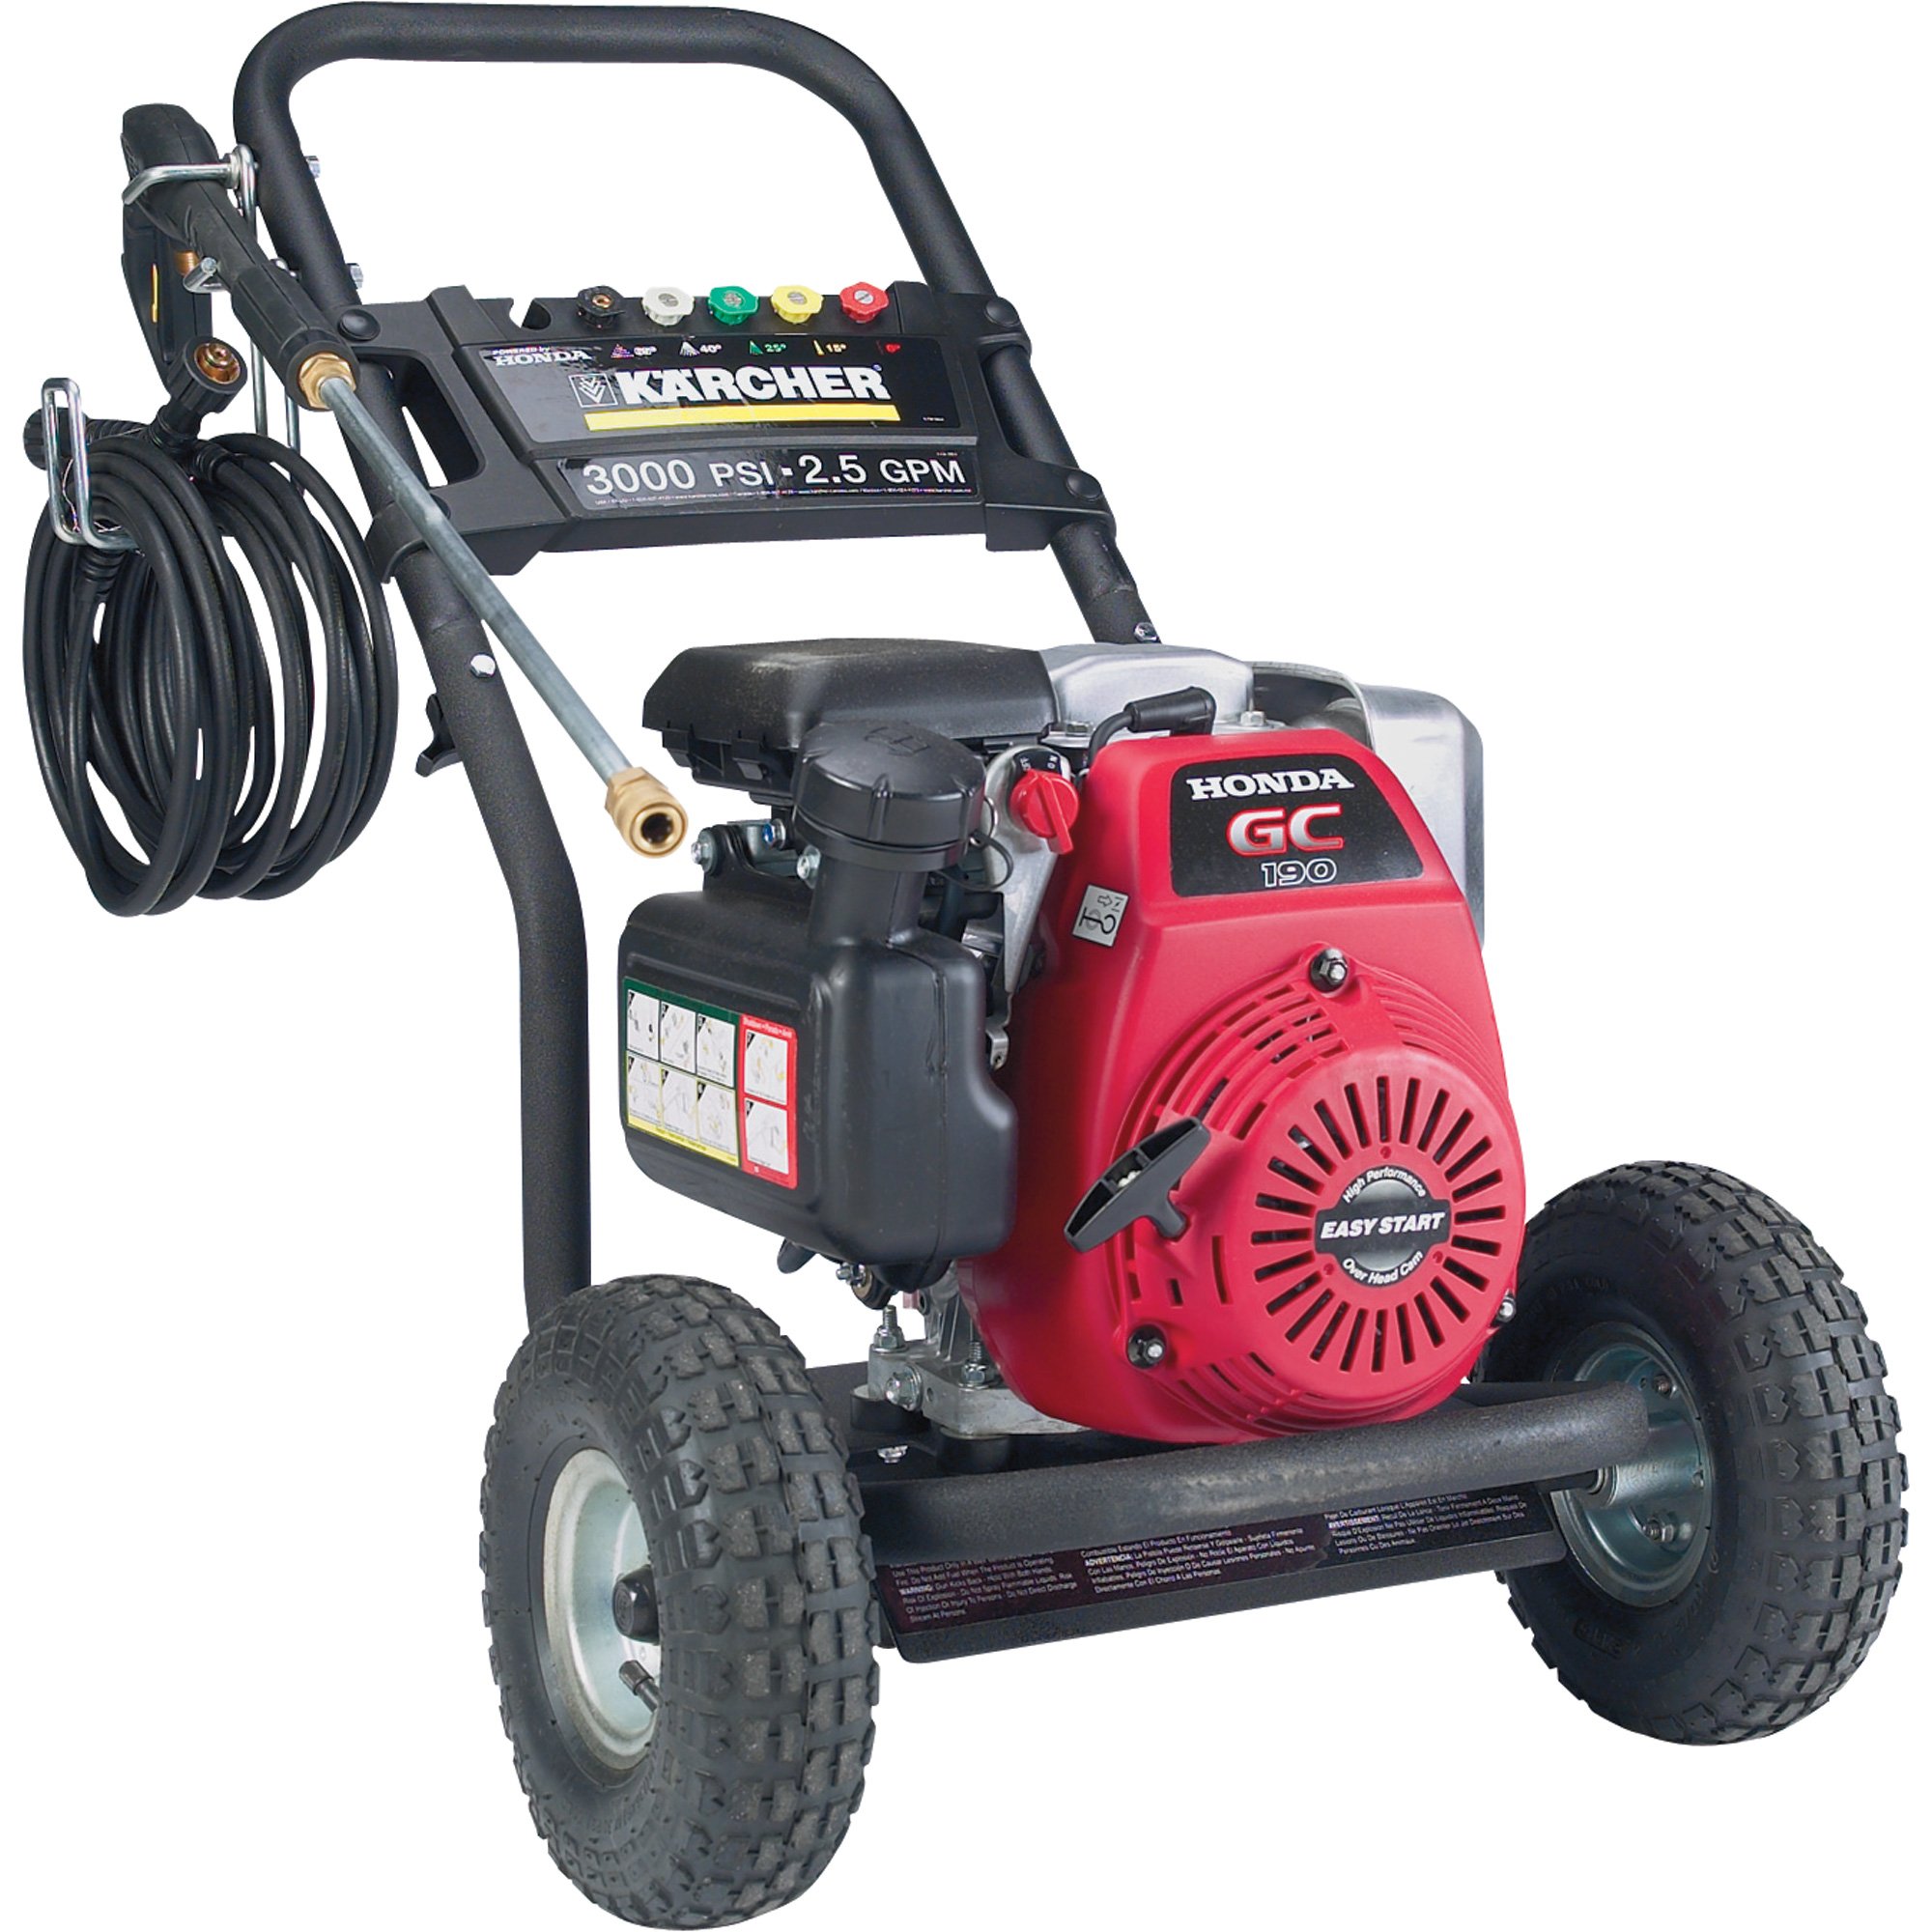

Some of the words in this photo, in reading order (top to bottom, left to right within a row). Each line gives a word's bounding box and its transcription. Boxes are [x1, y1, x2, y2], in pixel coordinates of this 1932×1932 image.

[495, 350, 592, 366] HONDA
[699, 344, 722, 354] 40°
[764, 343, 786, 353] 25°
[614, 365, 891, 406] KÄRCHER
[582, 459, 696, 496] 3000
[708, 461, 774, 487] PSI
[798, 454, 867, 484] 2.5
[879, 459, 966, 484] GPM
[1186, 768, 1354, 801] HONDA
[1226, 803, 1344, 857] GC
[1262, 858, 1337, 887] 190
[1342, 1177, 1366, 1204] High
[1366, 1166, 1427, 1198] Performance
[1321, 1217, 1378, 1239] EASY
[1378, 1212, 1446, 1235] START
[1342, 1257, 1367, 1281] Over
[1367, 1271, 1399, 1285] Head
[1400, 1250, 1424, 1276] Cam
